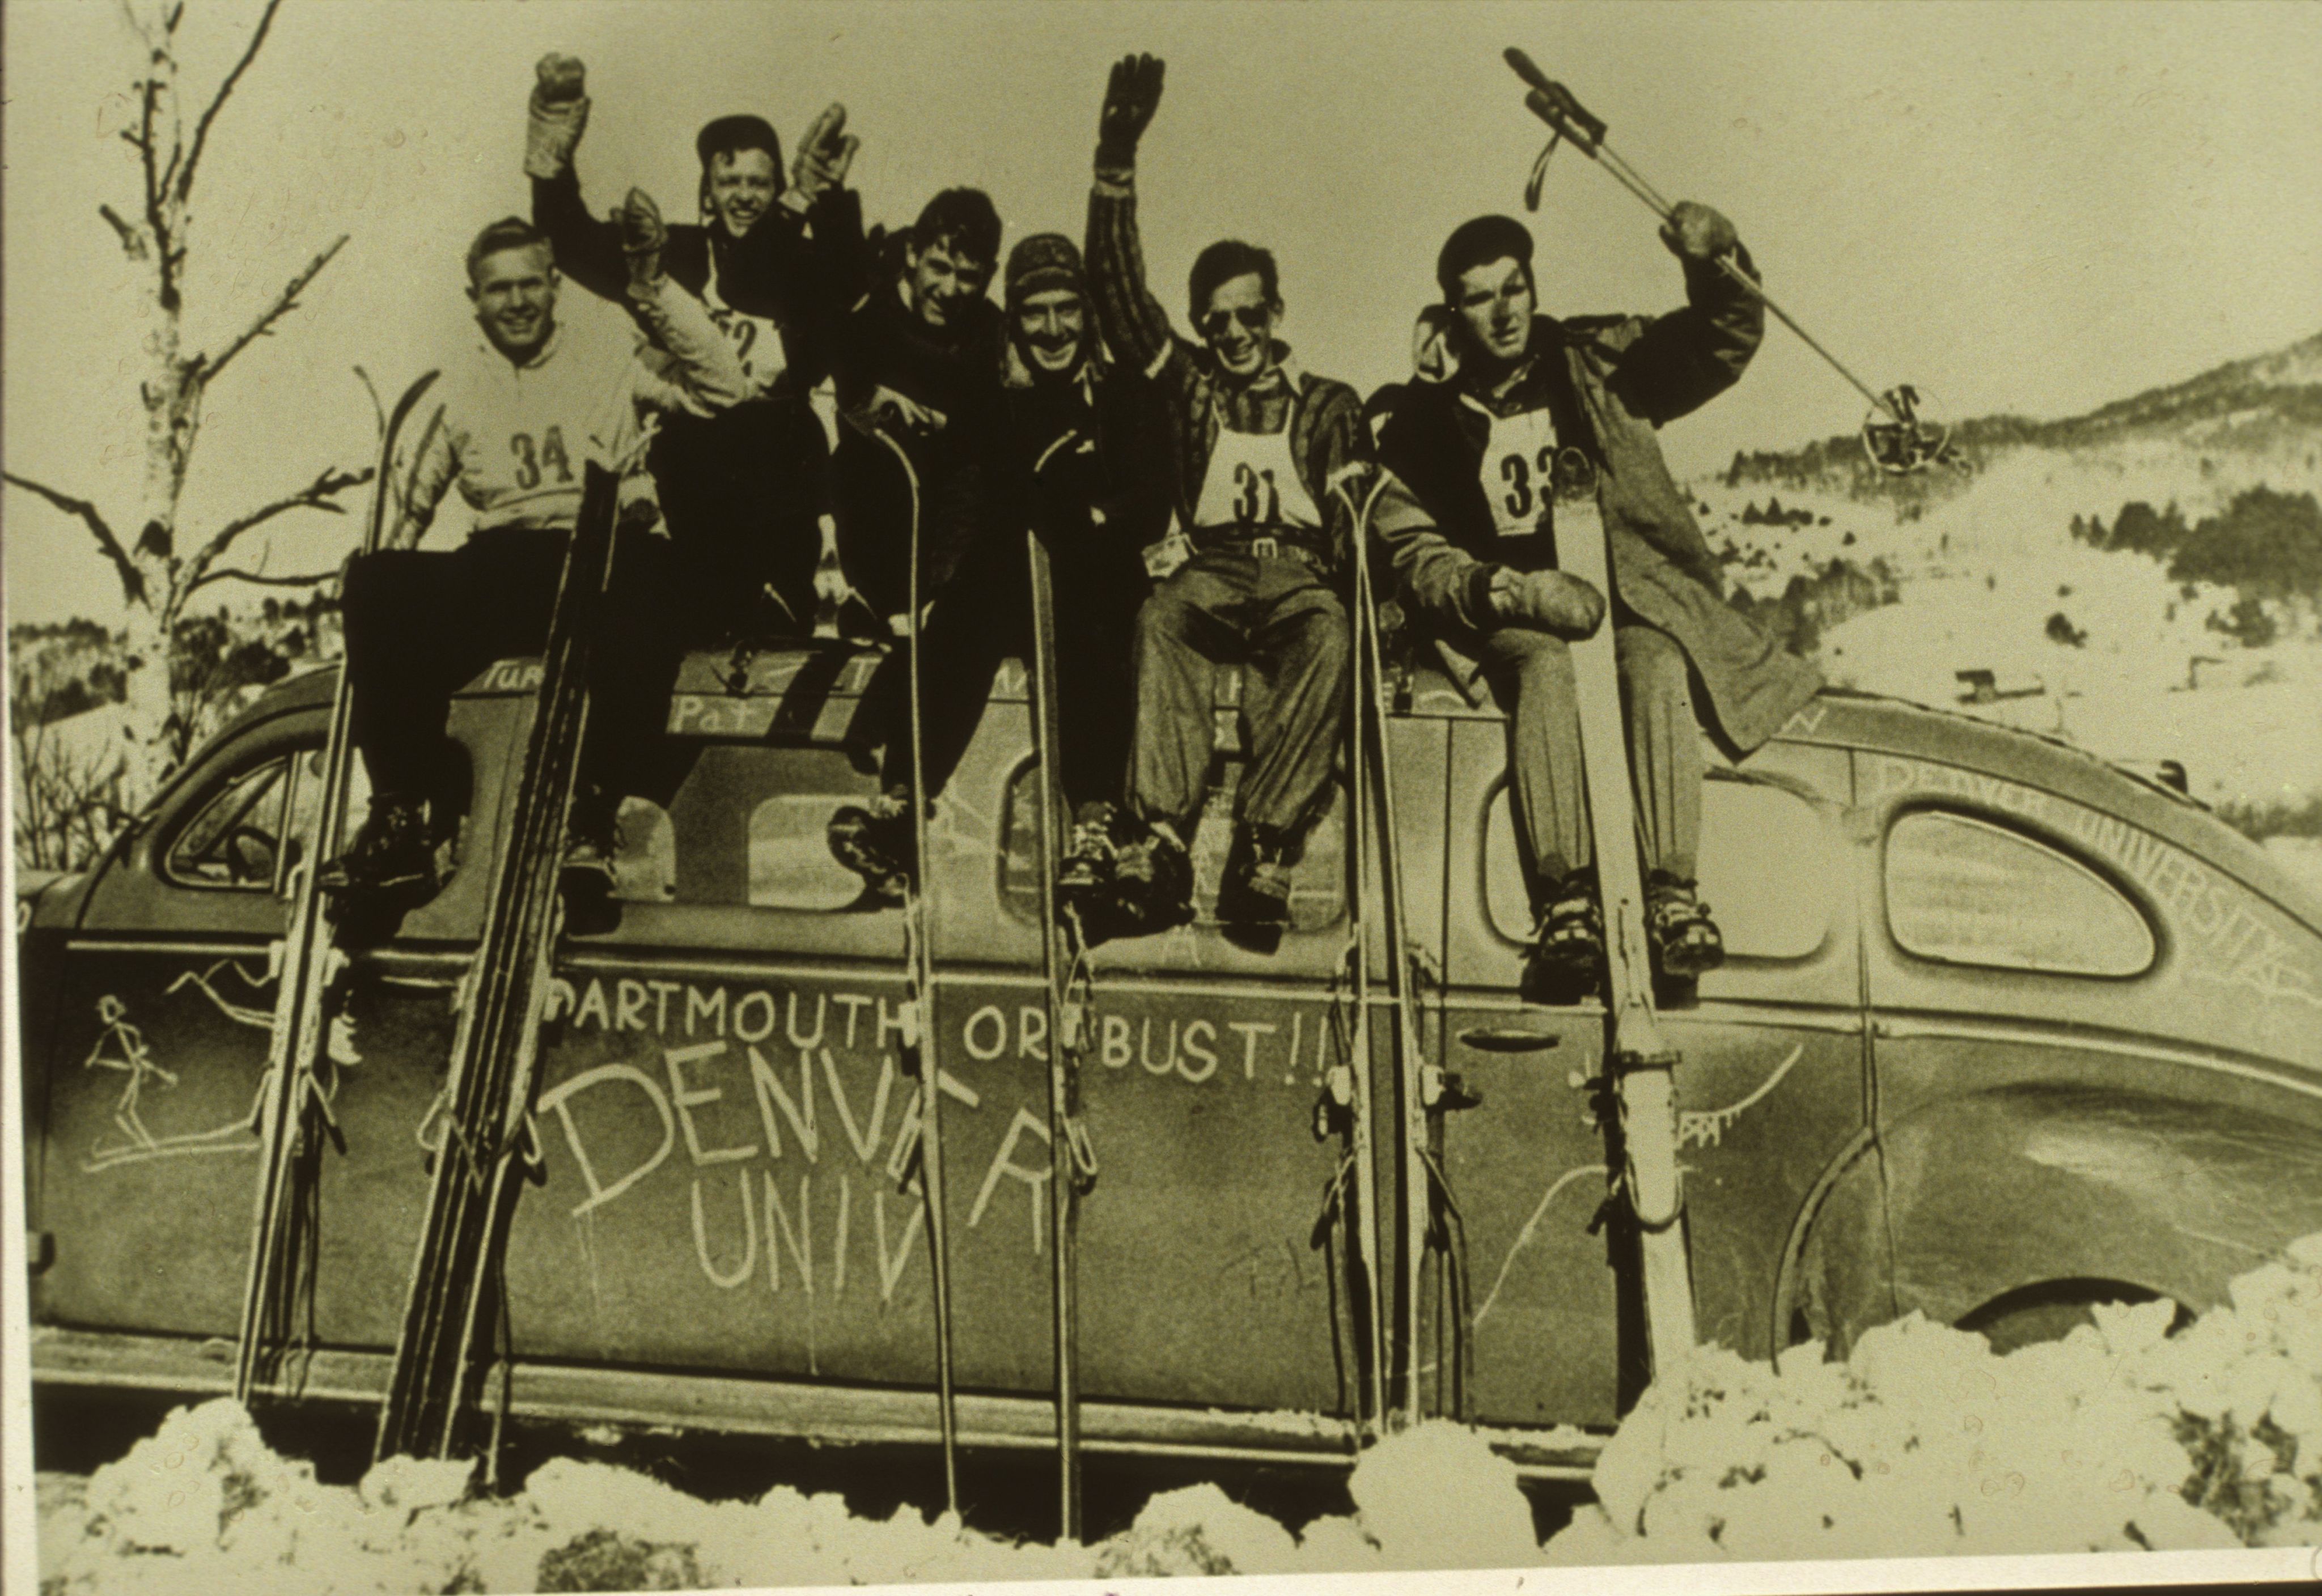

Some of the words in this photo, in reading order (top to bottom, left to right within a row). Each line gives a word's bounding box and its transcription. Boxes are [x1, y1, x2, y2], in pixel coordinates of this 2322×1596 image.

[510, 425, 574, 490] 34
[1233, 462, 1283, 524] 31
[1876, 755, 2048, 817] DENVER
[542, 976, 914, 1049] DARTMOUTH
[963, 1004, 1049, 1062] OR
[1101, 1011, 1328, 1089] BUST!!
[690, 1168, 926, 1301] UNIV
